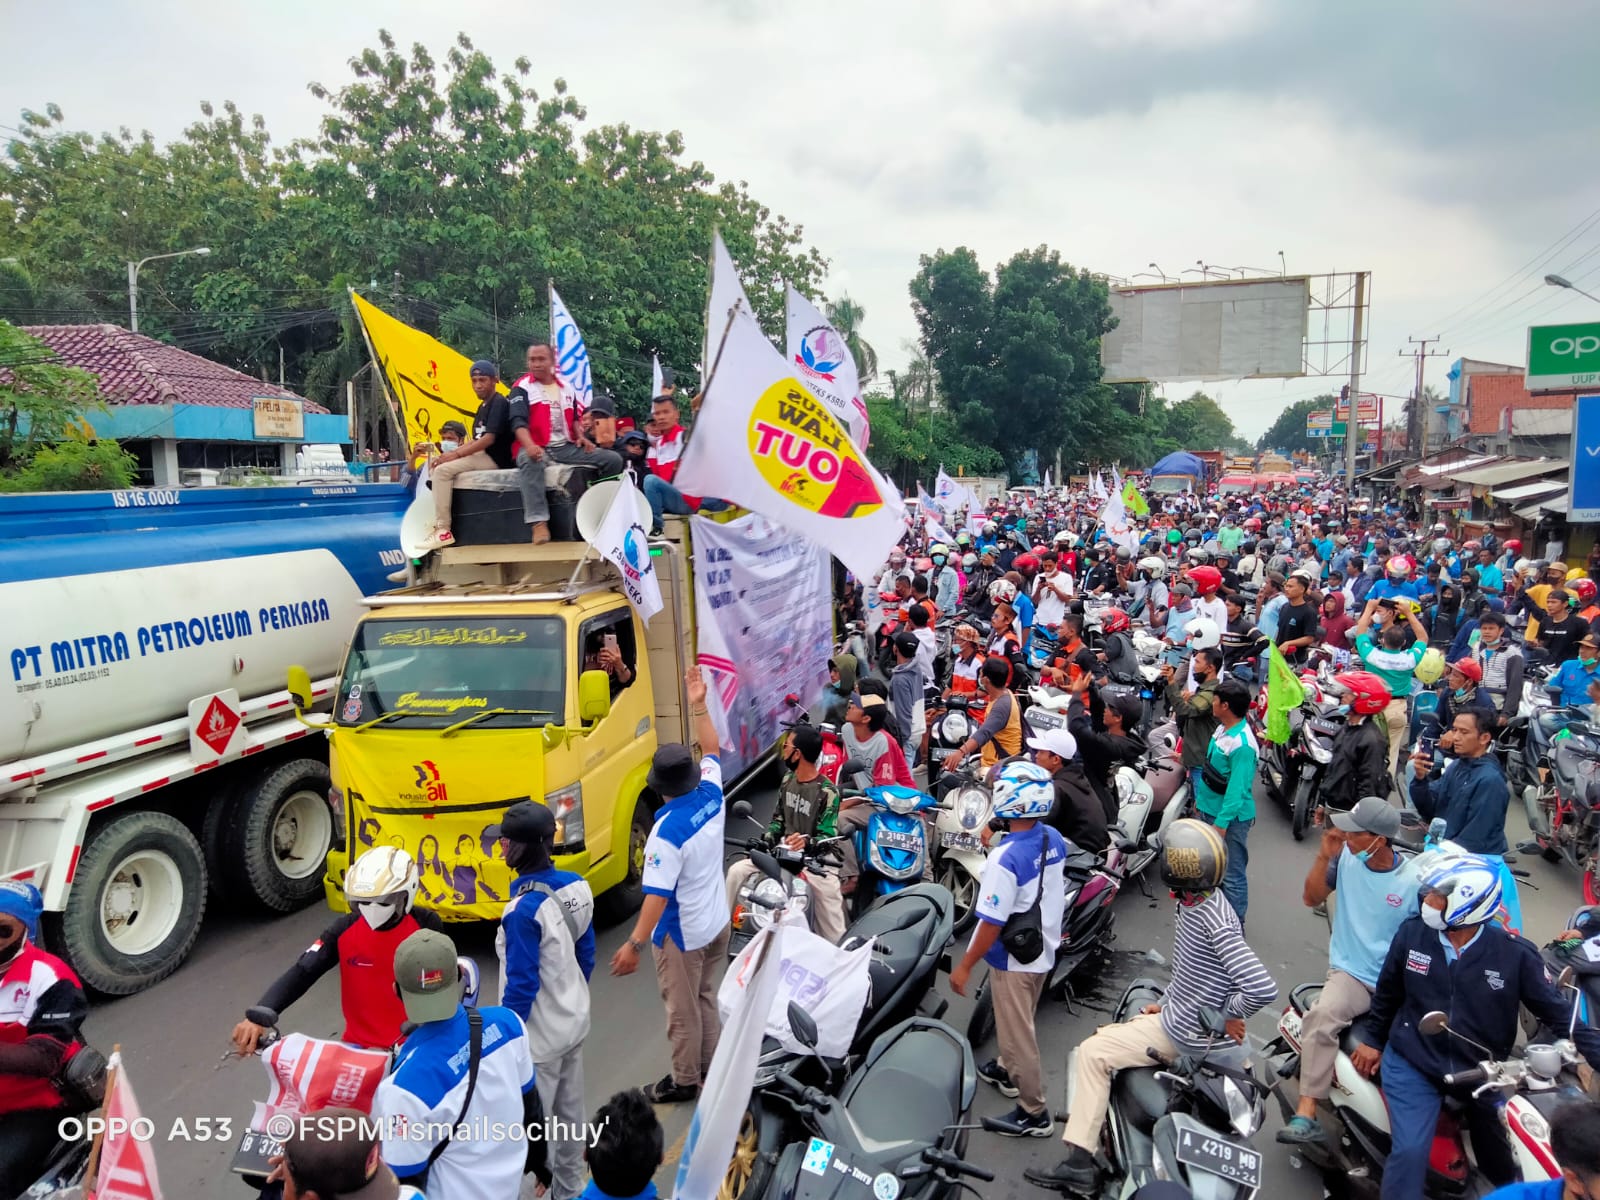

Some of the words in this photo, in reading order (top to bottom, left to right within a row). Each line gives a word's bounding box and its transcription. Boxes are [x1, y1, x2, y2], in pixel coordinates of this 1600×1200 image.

[1550, 335, 1600, 359] op
[112, 491, 130, 508] ISI
[378, 549, 405, 566] IND
[11, 646, 42, 681] PT
[50, 631, 130, 673] MITRA
[137, 609, 252, 656] PETROLEUM
[258, 598, 330, 633] PERKASA
[243, 1137, 253, 1152] B
[259, 1138, 285, 1156] 373
[1183, 1132, 1191, 1147] A
[1201, 1139, 1232, 1161] 4219
[1239, 1150, 1257, 1170] MB
